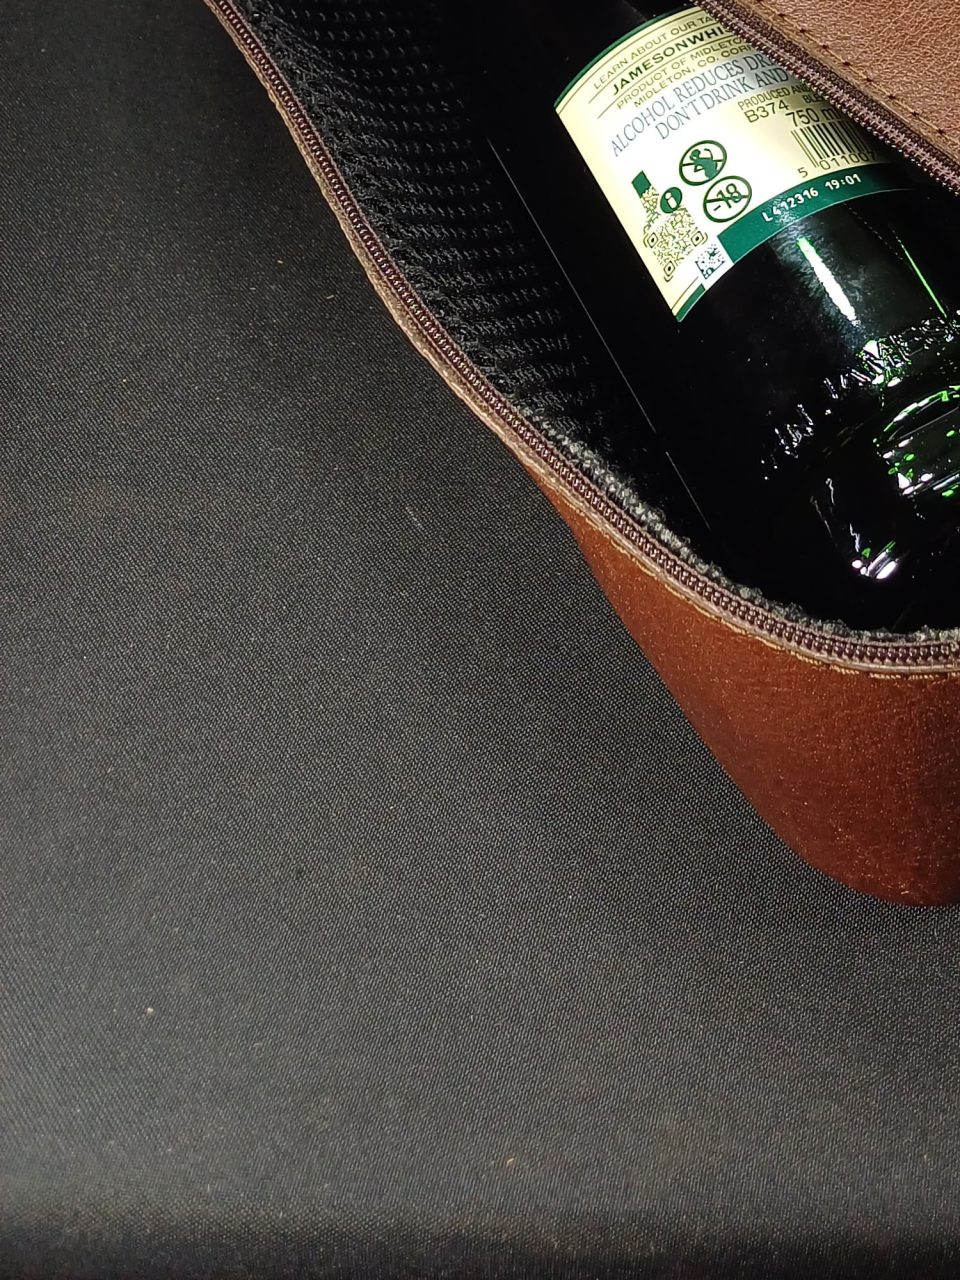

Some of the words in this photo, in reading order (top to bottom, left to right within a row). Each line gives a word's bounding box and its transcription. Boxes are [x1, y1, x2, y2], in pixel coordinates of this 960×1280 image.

[593, 58, 628, 90] LEARN
[630, 33, 668, 60] ABOUT
[670, 21, 698, 36] OUR
[617, 70, 668, 109] PRODUCT
[671, 58, 687, 71] OF
[690, 37, 744, 61] MIDLETO
[611, 95, 675, 157] ALCOHOL
[673, 59, 745, 103] REDUCES
[633, 67, 696, 108] MIDLETON,
[655, 98, 702, 140] DON'T
[699, 75, 752, 110] DRINK
[755, 66, 790, 88] AND
[737, 87, 791, 111] PRODUCED
[744, 99, 789, 123] B374
[785, 107, 820, 127] 750
[797, 166, 809, 179] 5
[762, 187, 819, 222] L412316
[824, 173, 862, 191] 19:01
